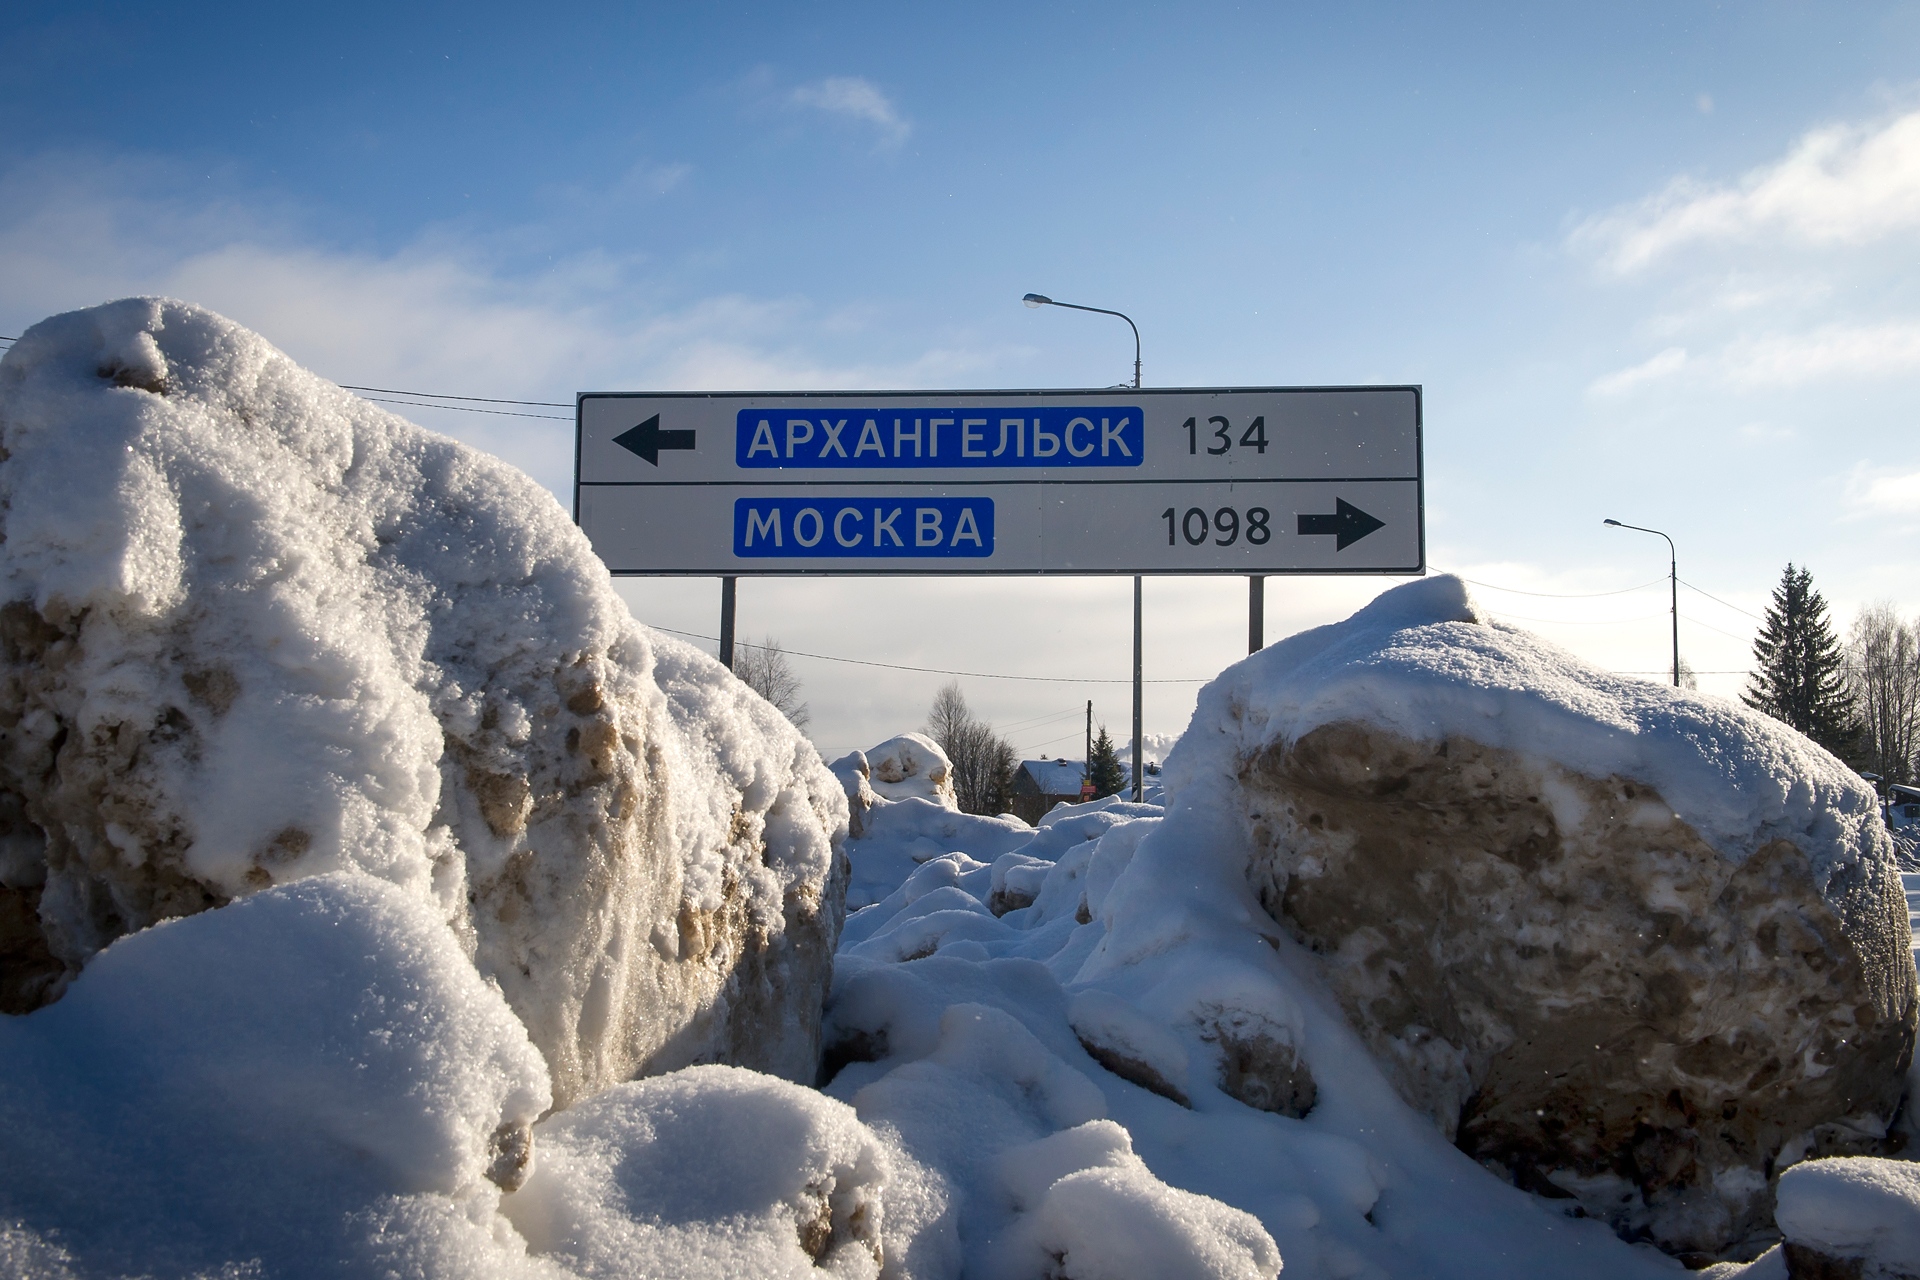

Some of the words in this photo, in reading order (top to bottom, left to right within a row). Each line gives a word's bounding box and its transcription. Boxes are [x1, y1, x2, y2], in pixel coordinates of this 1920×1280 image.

[747, 417, 1133, 459] АРХАНГЕЛЬСК
[1182, 416, 1269, 456] 134
[744, 507, 983, 548] МОСКВА
[1161, 507, 1271, 547] 1098
